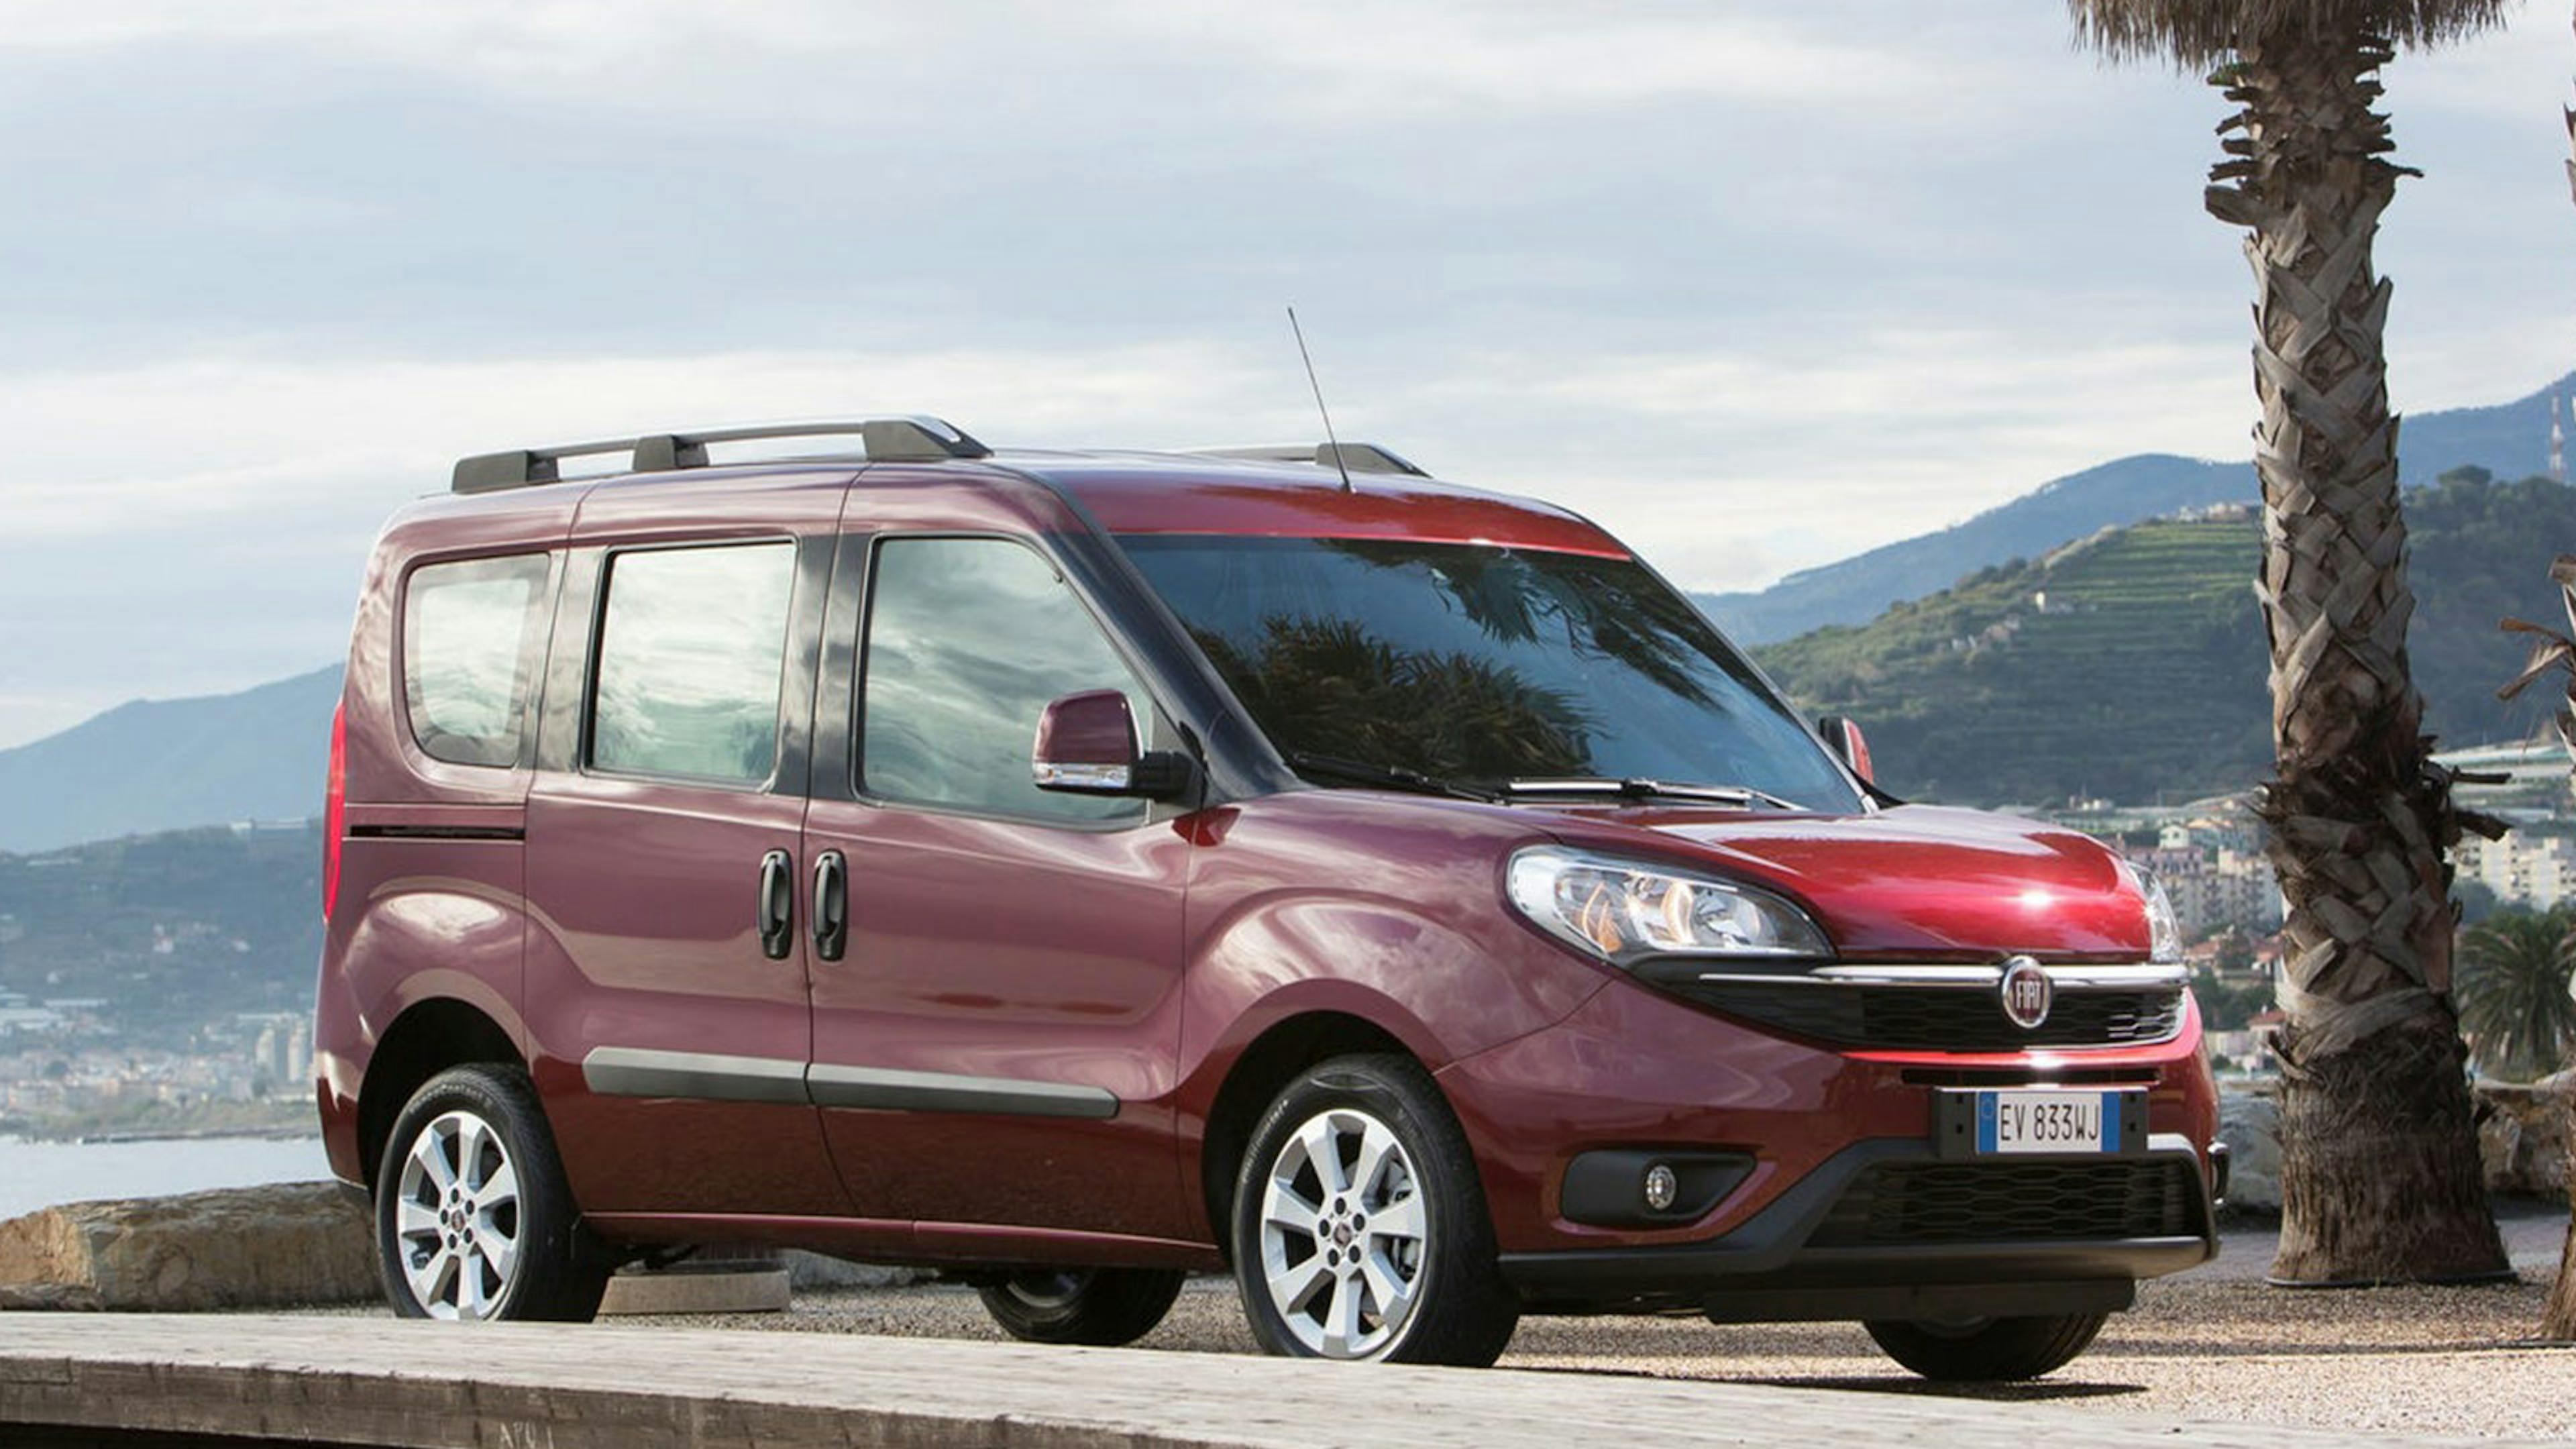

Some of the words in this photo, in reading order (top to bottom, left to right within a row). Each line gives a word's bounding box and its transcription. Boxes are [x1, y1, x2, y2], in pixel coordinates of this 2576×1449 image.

[2015, 980, 2041, 1009] FIAT
[2000, 1104, 2026, 1140] EV
[2033, 1104, 2100, 1140] 833WJ
